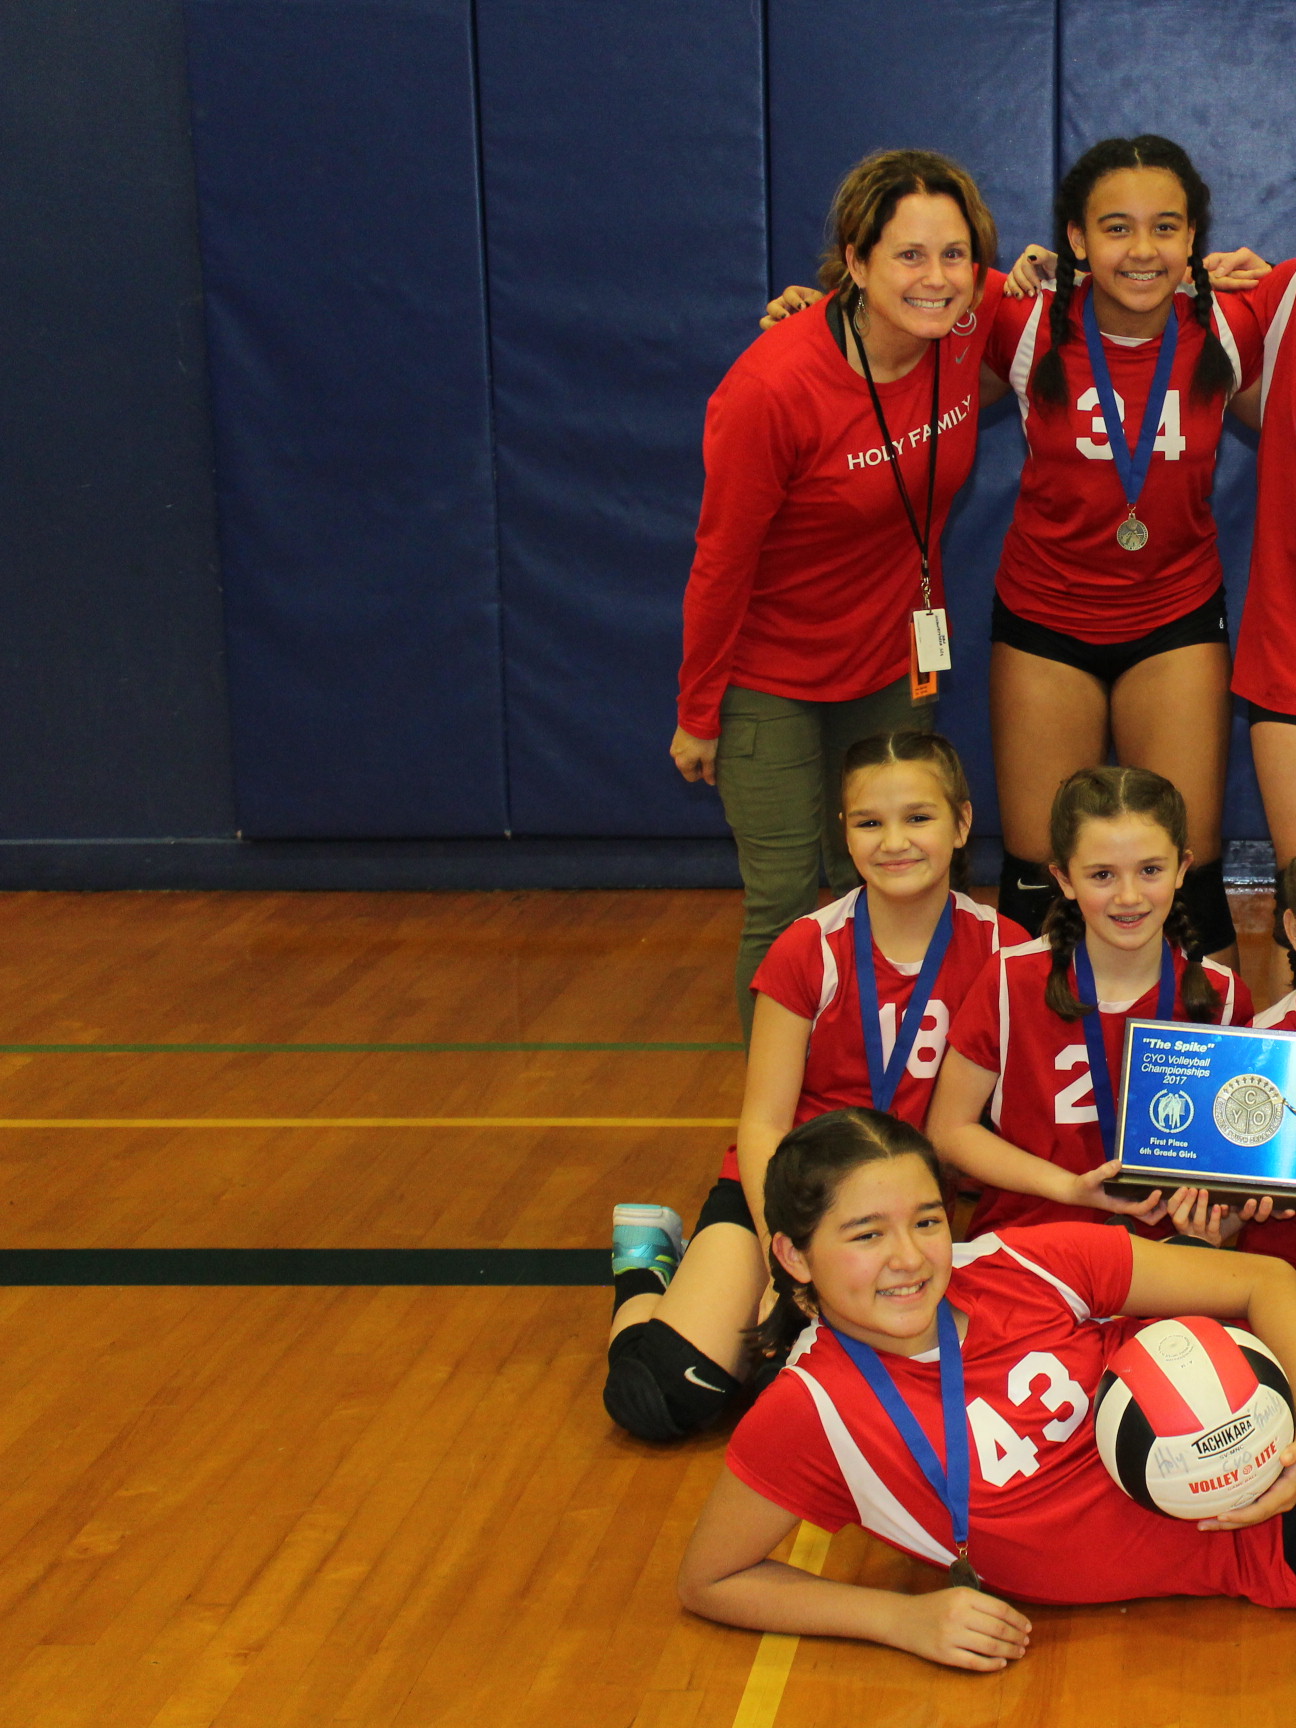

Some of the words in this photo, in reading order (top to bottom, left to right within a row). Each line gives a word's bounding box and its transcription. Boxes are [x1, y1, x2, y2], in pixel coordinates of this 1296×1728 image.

[847, 438, 905, 470] HOLY
[908, 394, 971, 448] FAMILY
[1076, 387, 1186, 460] 34
[878, 999, 949, 1079] 18
[1141, 1063, 1211, 1078] Championships
[1143, 1053, 1166, 1063] CYO
[1168, 1055, 1211, 1067] Volleyball
[1163, 1075, 1187, 1085] 2017
[1139, 1147, 1152, 1155] 6th
[1153, 1148, 1177, 1157] Grade
[1178, 1150, 1197, 1159] Girls
[1150, 1137, 1166, 1146] First
[1168, 1138, 1188, 1148] Place
[966, 1351, 1090, 1488] 43
[1191, 1418, 1253, 1454] TACHIKARA
[1188, 1469, 1239, 1494] VOLLEY
[1254, 1440, 1278, 1468] LITE
